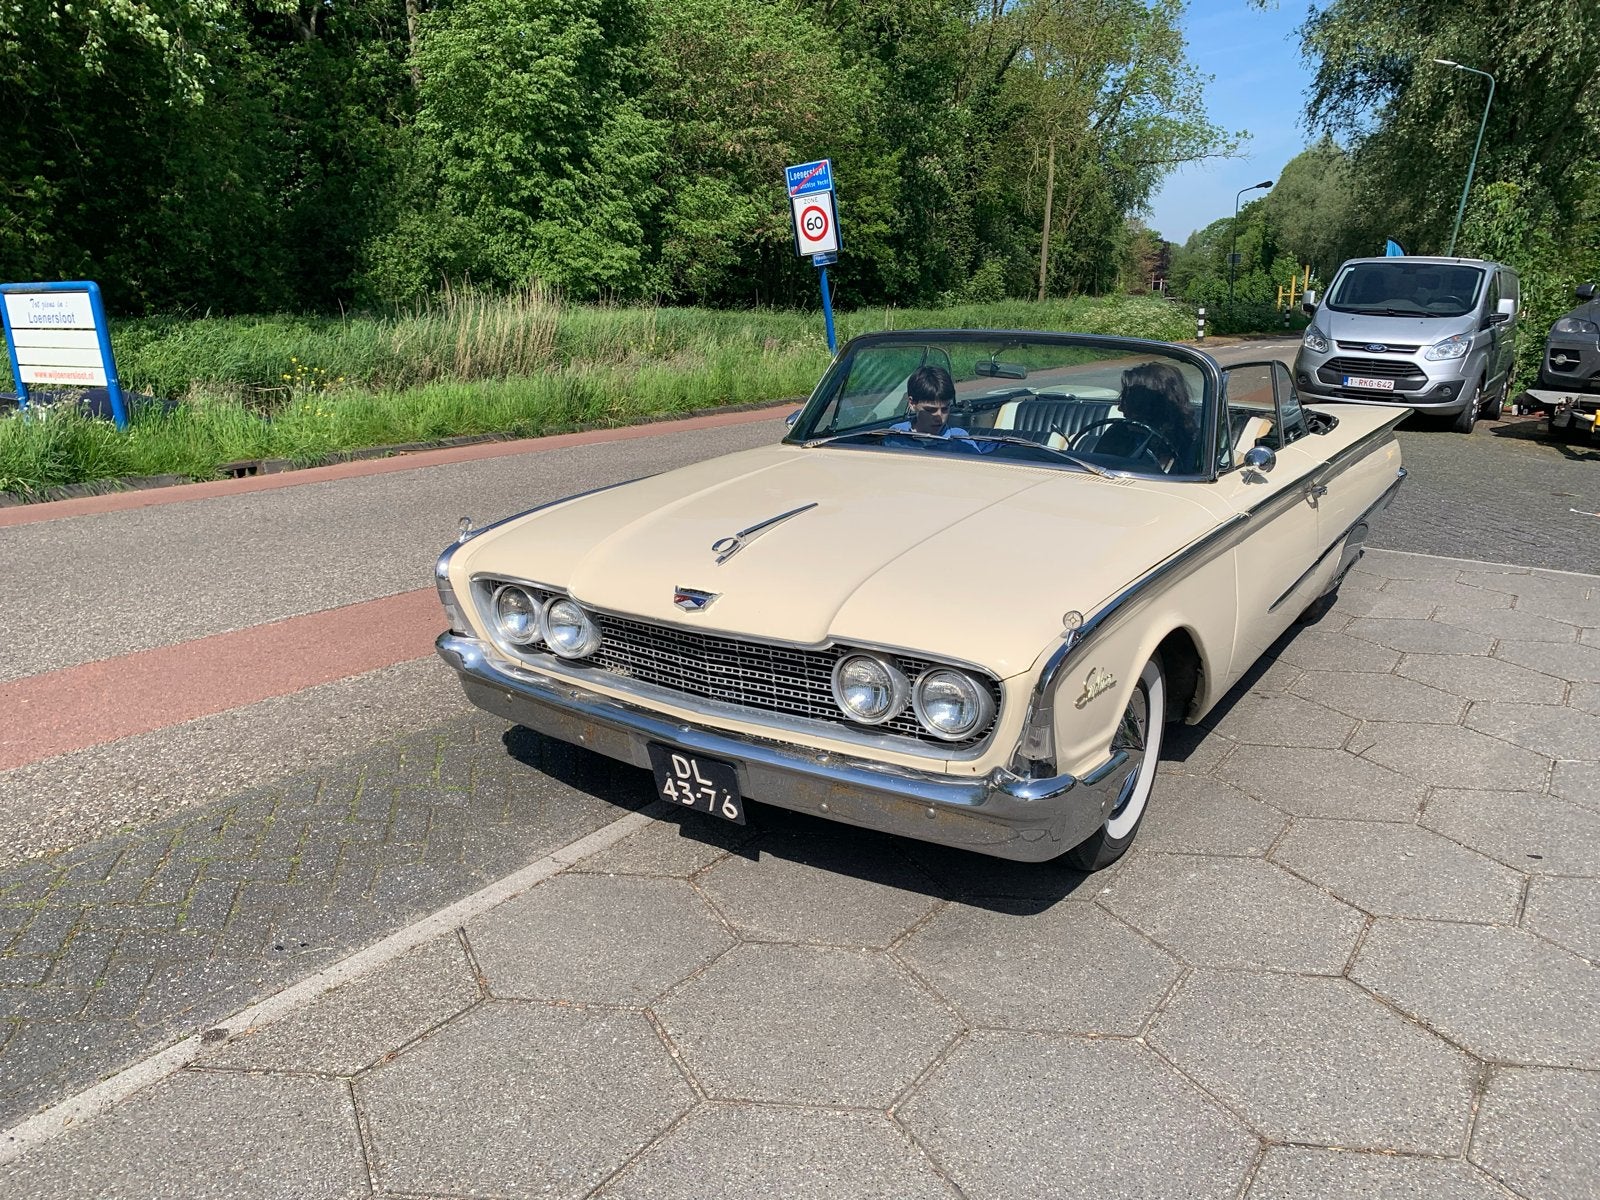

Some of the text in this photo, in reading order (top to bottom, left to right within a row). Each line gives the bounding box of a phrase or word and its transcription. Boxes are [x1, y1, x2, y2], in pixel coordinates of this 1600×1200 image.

[803, 197, 819, 205] ZONE
[806, 216, 824, 231] 60
[28, 312, 76, 324] Loenersloot
[671, 754, 713, 787] DL
